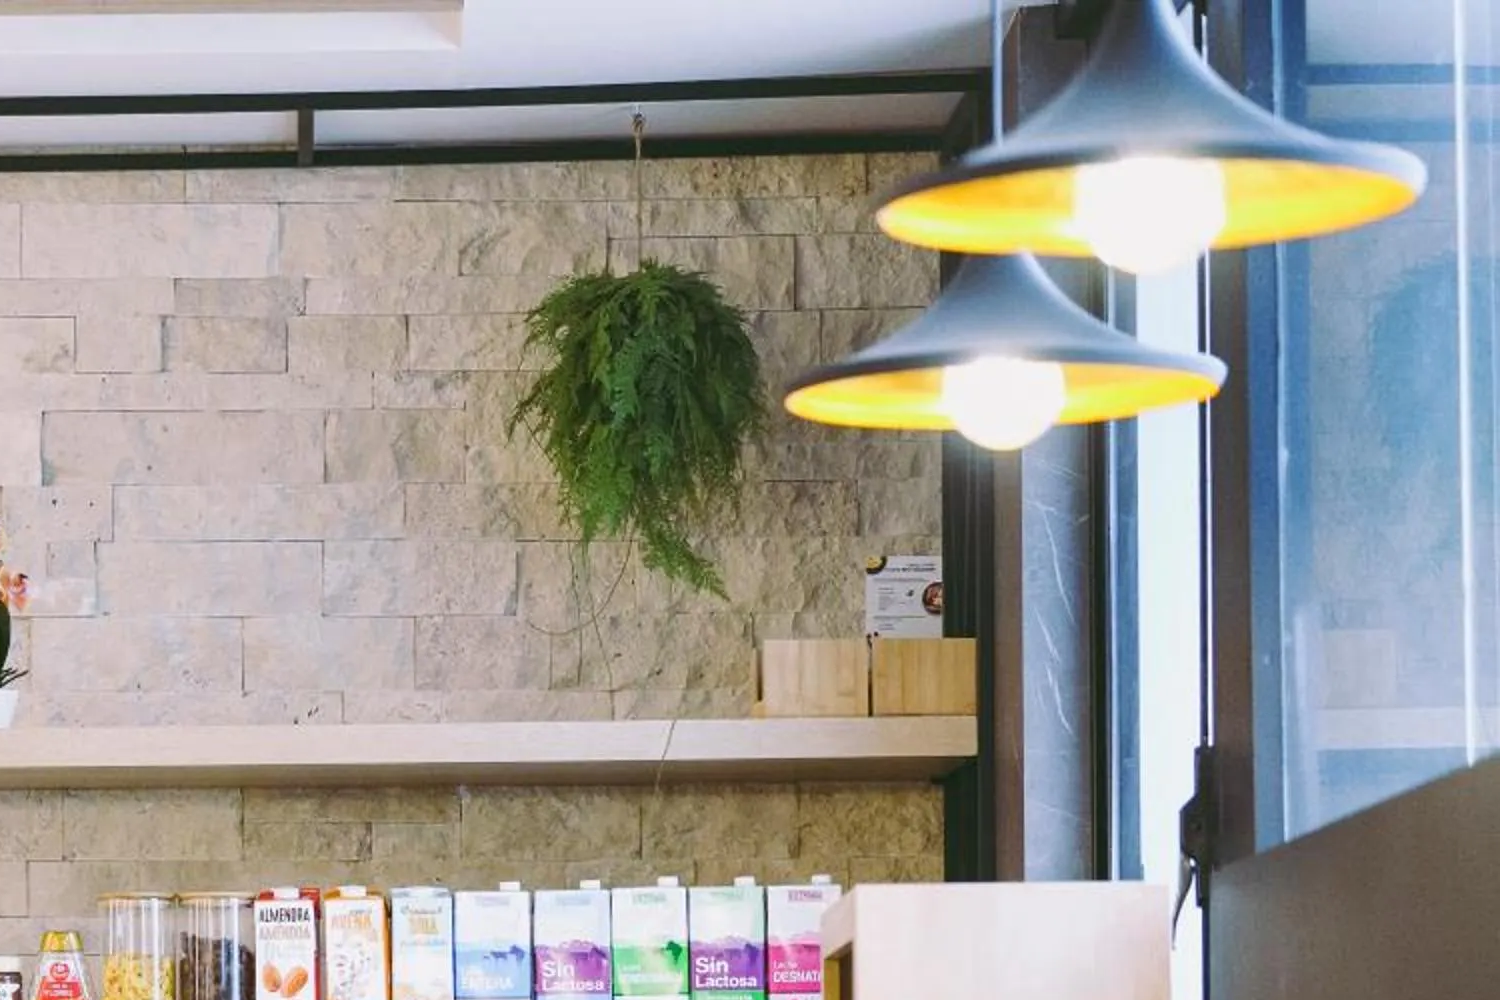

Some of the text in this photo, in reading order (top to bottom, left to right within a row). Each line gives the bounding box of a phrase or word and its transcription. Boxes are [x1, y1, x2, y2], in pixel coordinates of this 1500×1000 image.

[259, 907, 311, 923] ALMENDRA
[541, 957, 575, 978] Sin
[695, 955, 729, 974] Sin
[541, 978, 605, 992] Lactosa
[695, 973, 758, 989] Lactosa
